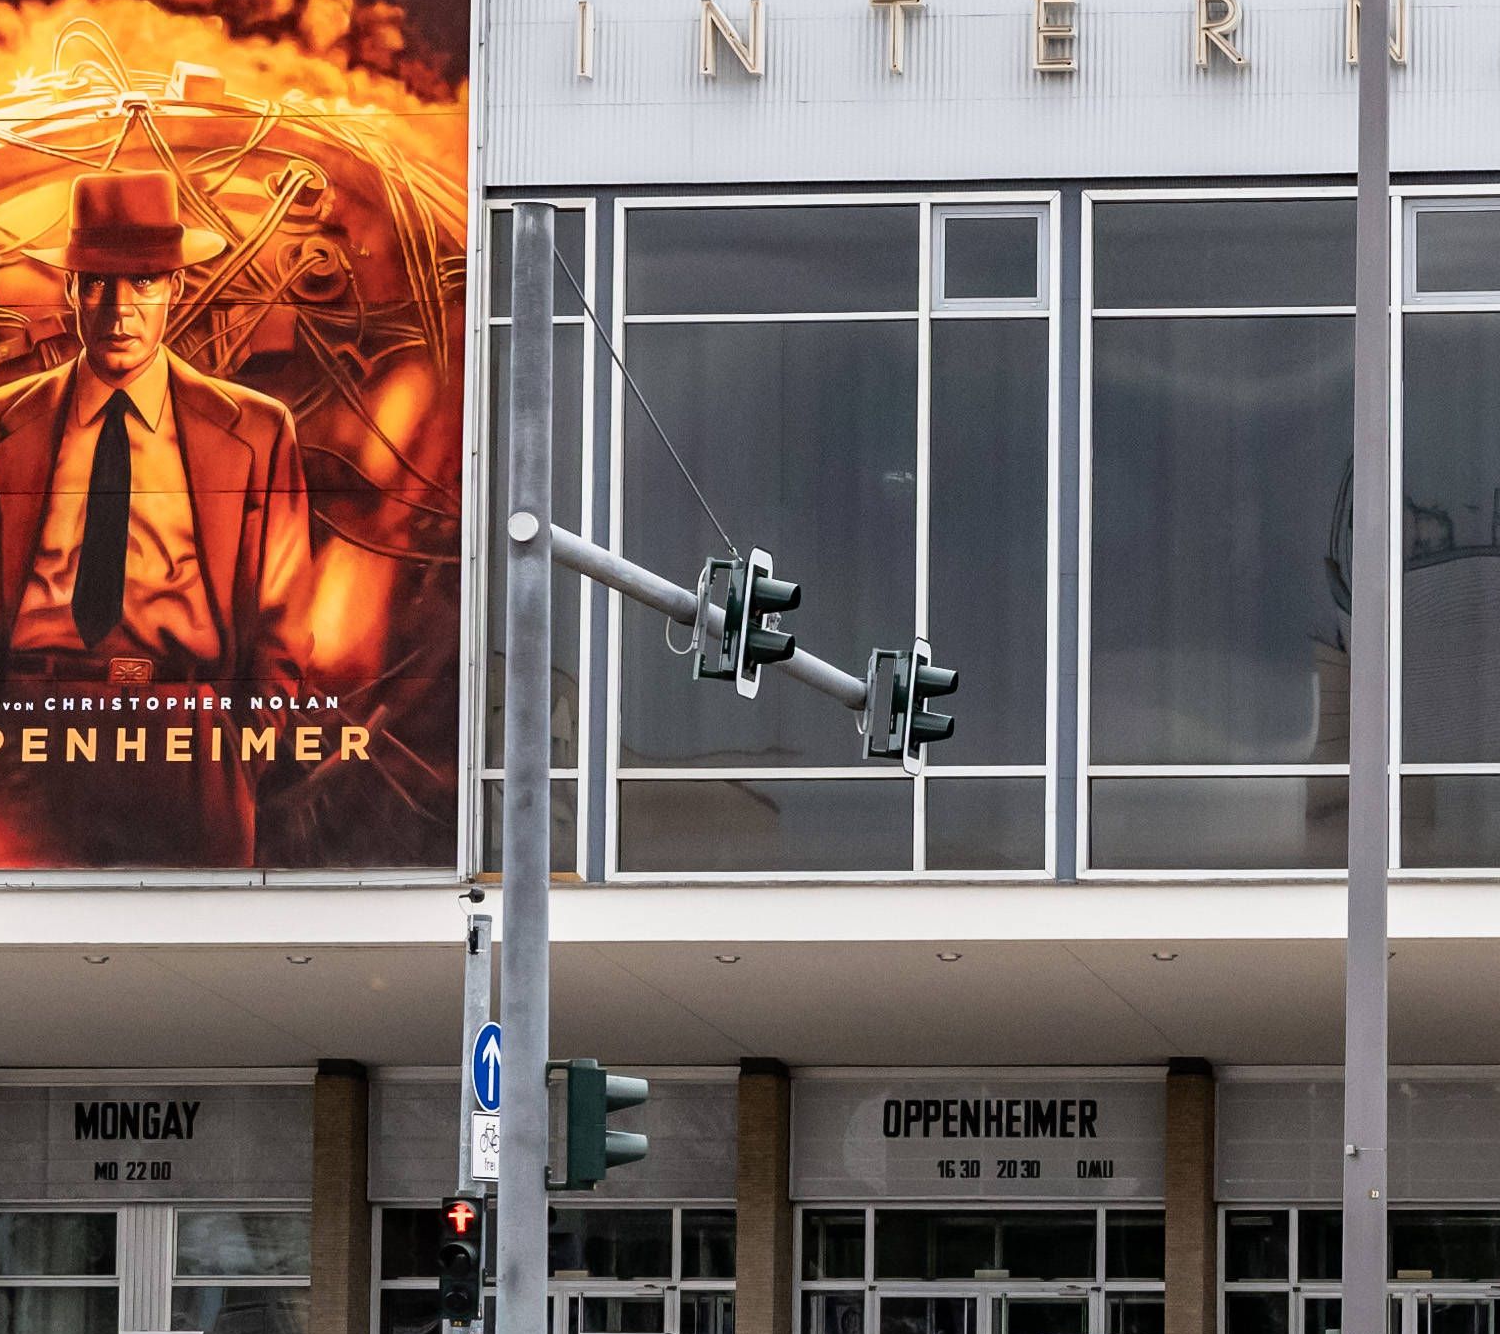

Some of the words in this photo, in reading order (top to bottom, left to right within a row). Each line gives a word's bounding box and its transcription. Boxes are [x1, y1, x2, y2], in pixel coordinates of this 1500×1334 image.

[2, 701, 35, 711] VON
[45, 697, 231, 710] CHRISTOPHER
[251, 697, 337, 709] NOLAN
[75, 1102, 200, 1139] MONGAY
[884, 1100, 1097, 1137] OPPENHEIMER
[95, 1162, 118, 1180] MO
